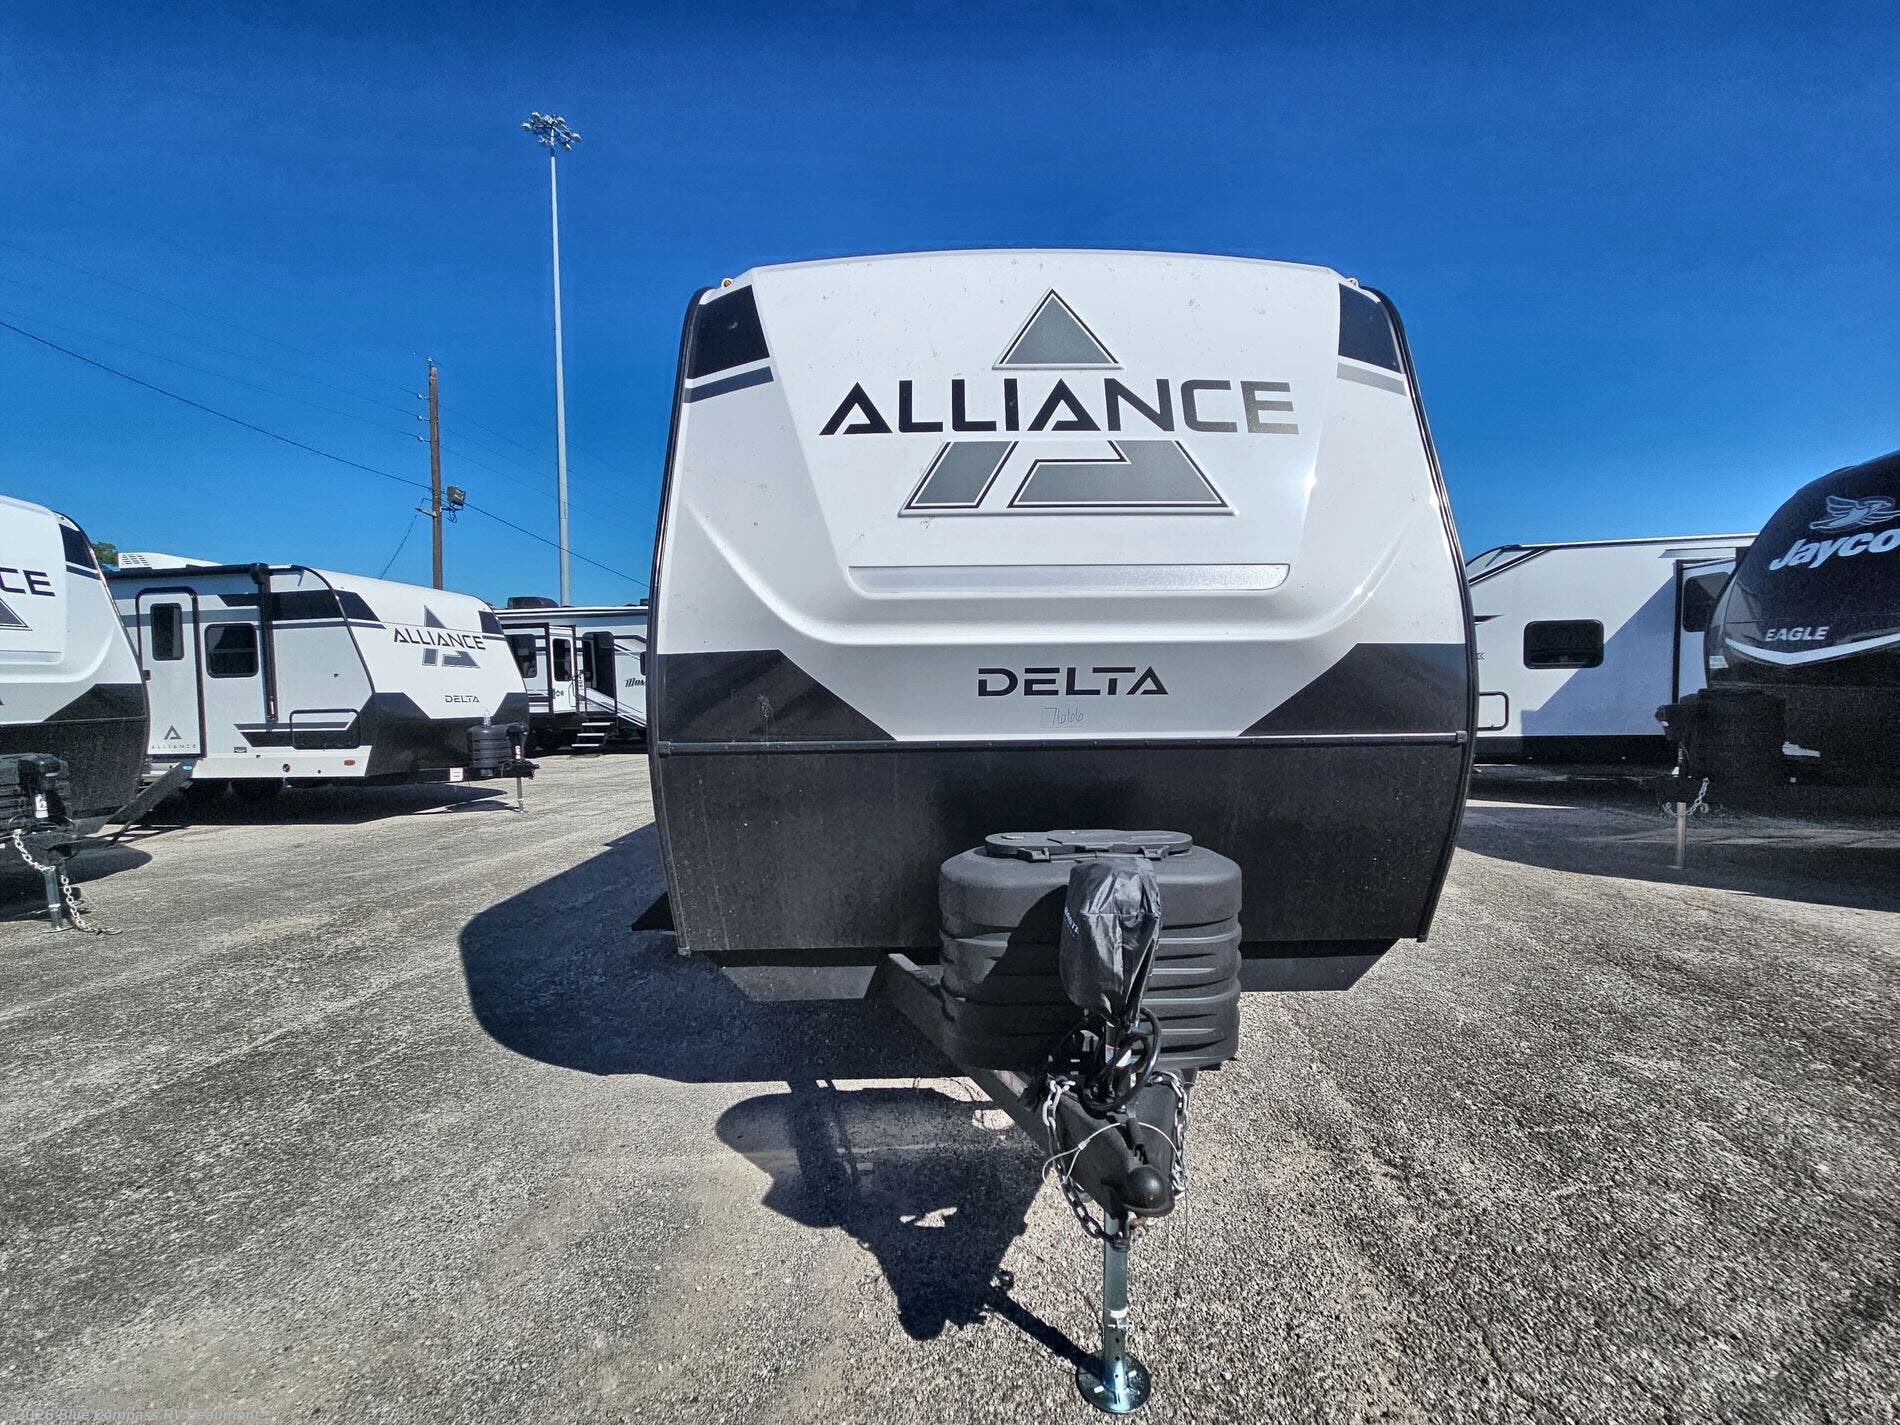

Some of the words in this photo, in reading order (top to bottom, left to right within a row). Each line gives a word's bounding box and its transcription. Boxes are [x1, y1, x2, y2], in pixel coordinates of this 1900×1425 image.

[819, 378, 1299, 435] ALLIANCE
[1769, 528, 1900, 571] Jayco
[393, 627, 486, 650] ALLIANCE
[1764, 626, 1830, 642] EAGLE
[978, 666, 1169, 696] DELTA
[444, 695, 480, 703] DELTA
[1042, 706, 1084, 726] 7666
